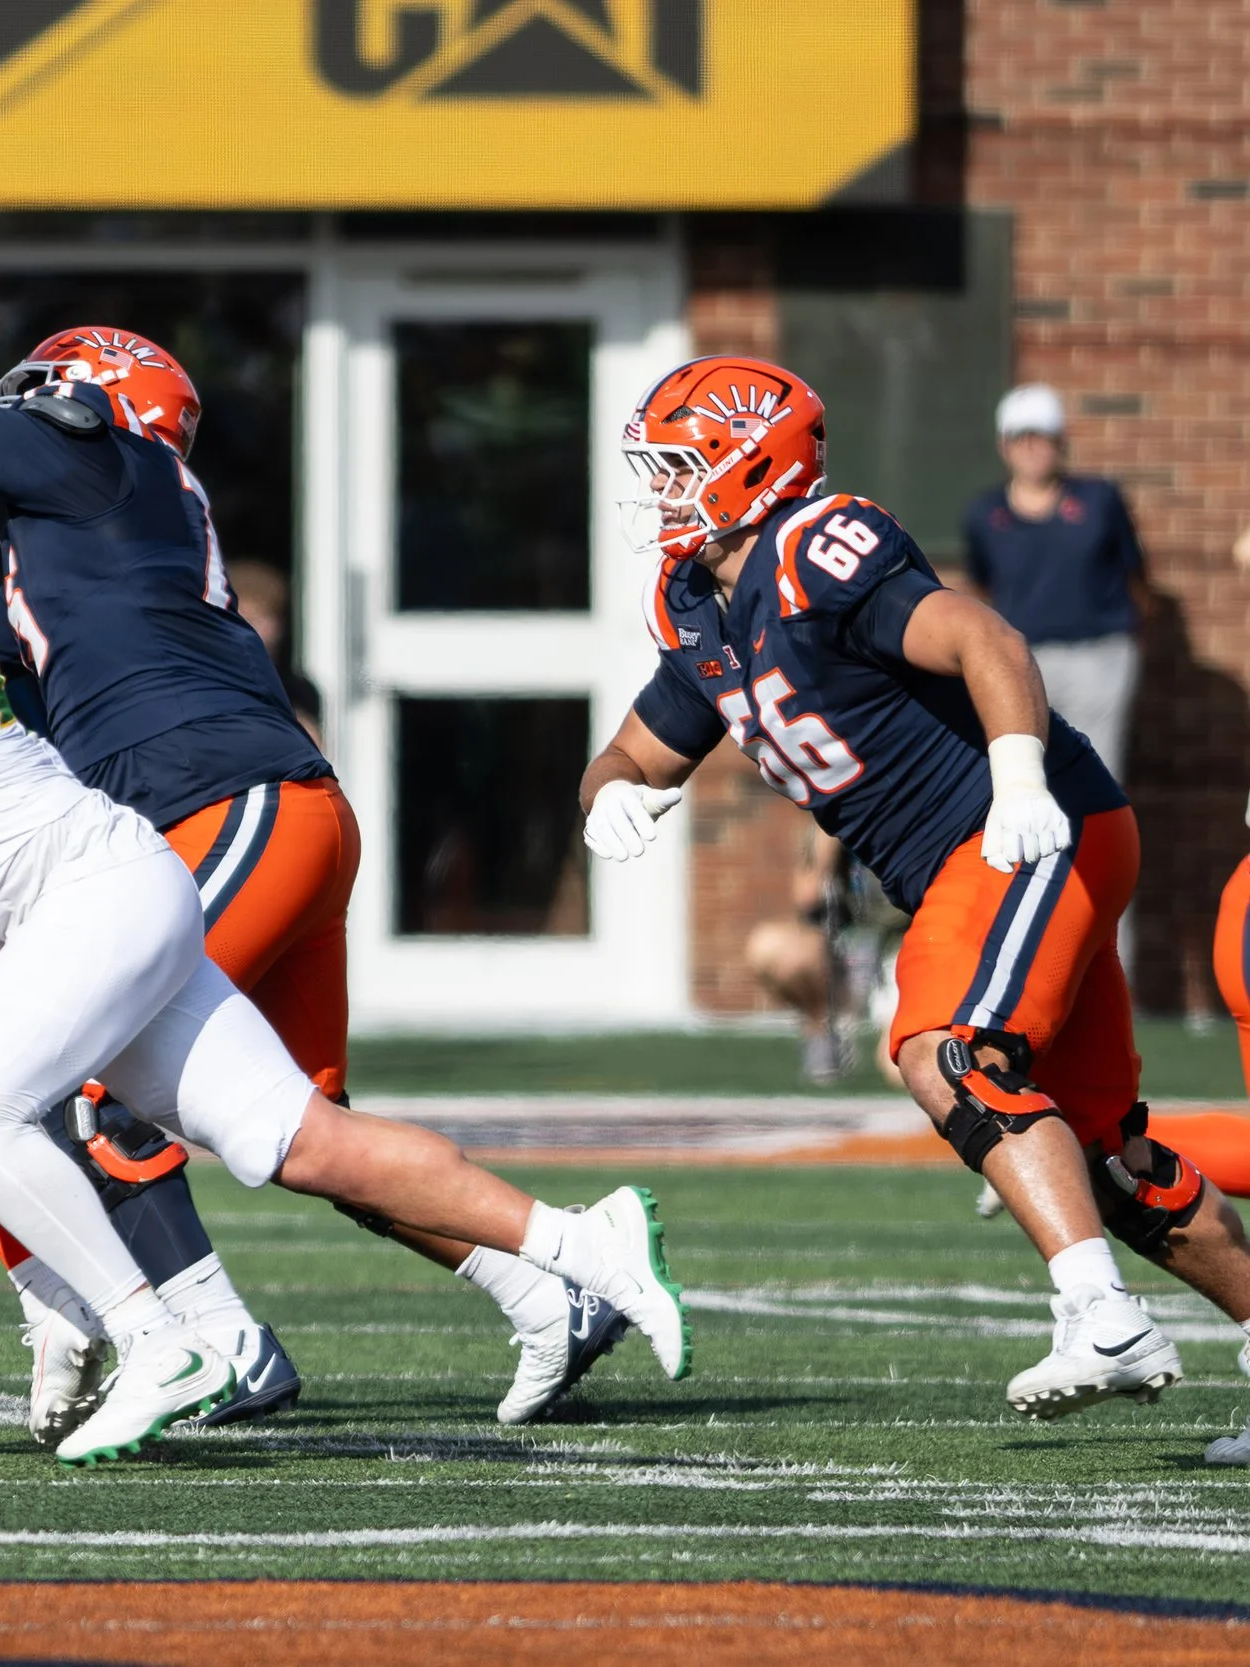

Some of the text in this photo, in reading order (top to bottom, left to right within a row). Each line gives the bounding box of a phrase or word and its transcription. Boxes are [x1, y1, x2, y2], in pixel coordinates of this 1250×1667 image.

[74, 330, 167, 369] ILLINI
[693, 384, 793, 425] ILLINI
[806, 513, 880, 582] 66
